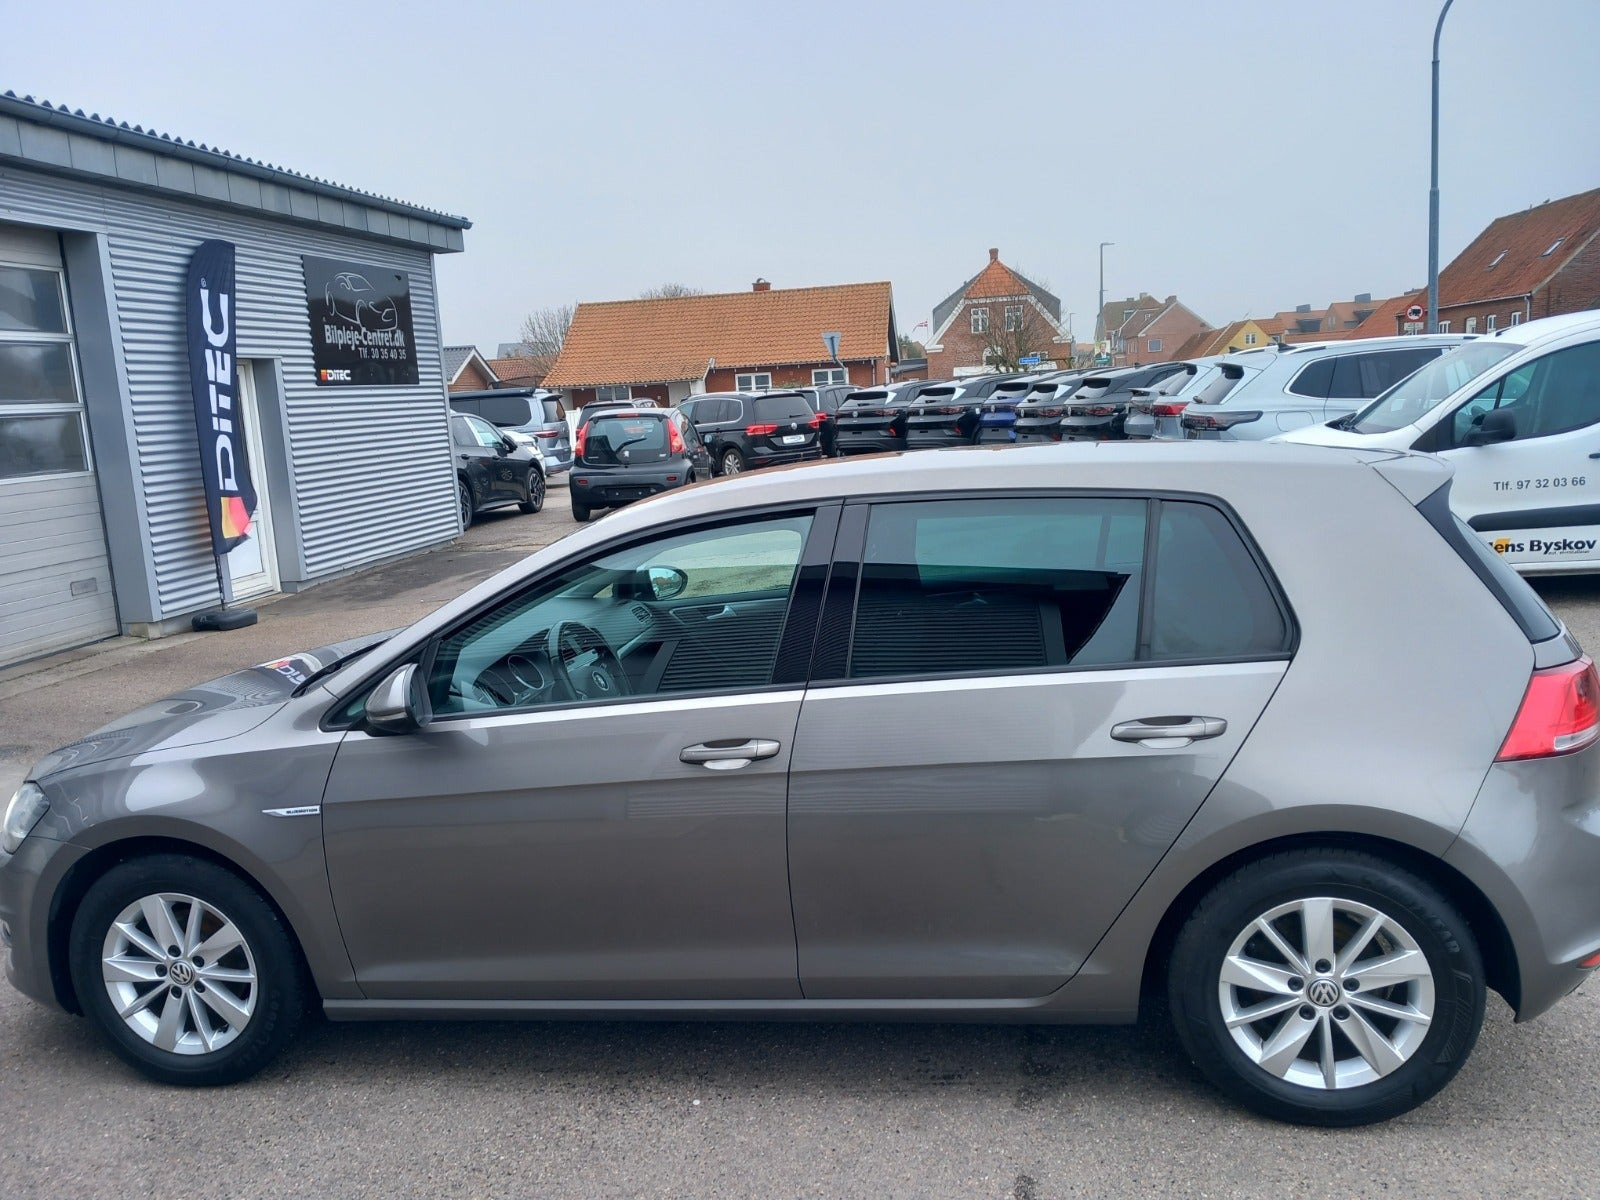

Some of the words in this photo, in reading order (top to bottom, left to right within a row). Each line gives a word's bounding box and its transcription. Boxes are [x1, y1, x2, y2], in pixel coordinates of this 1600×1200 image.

[324, 324, 405, 351] Bilpleje-Centret.dk
[358, 347, 370, 359] Tlf.
[371, 347, 380, 359] 30
[380, 348, 389, 360] 35
[398, 348, 407, 360] 35
[326, 369, 352, 380] DITEC
[200, 288, 239, 491] DITEC
[1493, 480, 1513, 491] Tlf.
[1516, 479, 1531, 490] 97
[1535, 478, 1550, 489] 32
[1553, 477, 1568, 488] 03
[1571, 476, 1586, 487] 66
[1529, 538, 1597, 555] Byskov
